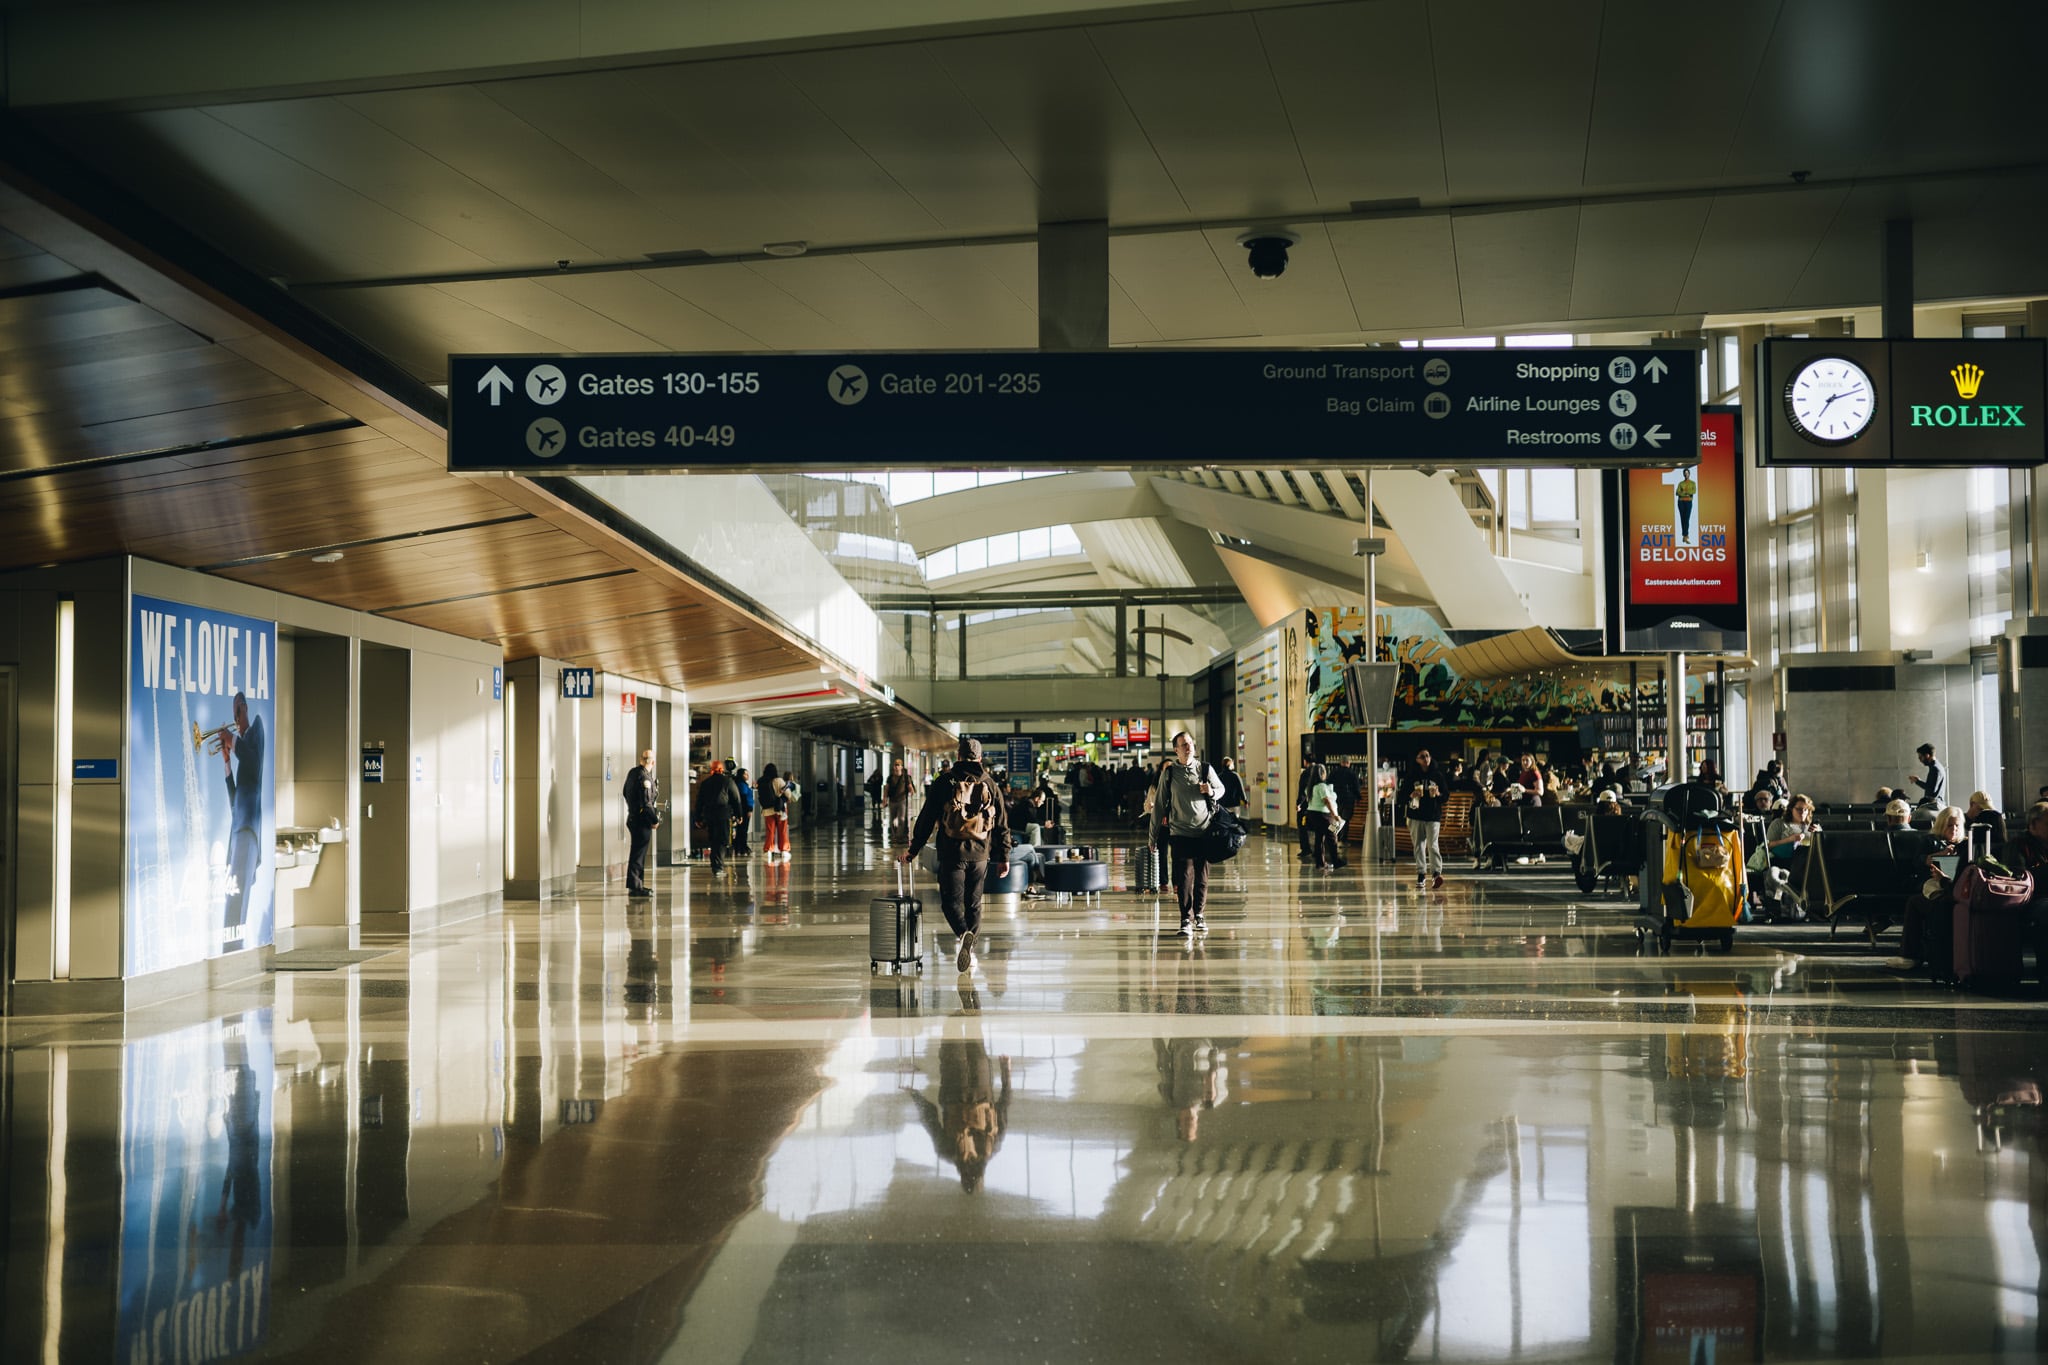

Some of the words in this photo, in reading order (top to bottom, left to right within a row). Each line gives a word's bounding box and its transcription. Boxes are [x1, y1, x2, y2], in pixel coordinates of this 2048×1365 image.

[1263, 364, 1327, 379] Ground
[1332, 364, 1415, 383] Transport
[1516, 363, 1600, 383] Shopping
[578, 373, 655, 396] Gates
[662, 372, 760, 395] 130-155
[880, 373, 937, 395] Gate
[944, 373, 1041, 394] 201-235
[1327, 398, 1360, 416] Bag
[1366, 397, 1415, 413] Claim
[1466, 396, 1521, 412] Airline
[1526, 396, 1600, 416] Lounges
[1911, 405, 2025, 426] ROLEX
[578, 425, 656, 449] Gates
[663, 425, 735, 447] 40-49
[1507, 429, 1601, 446] Restrooms
[1641, 525, 1672, 533] EVERY
[1700, 525, 1726, 533] WITH
[1640, 548, 1726, 561] BELONGS
[1670, 621, 1700, 629] JCDecaux
[140, 609, 177, 690] WE
[185, 618, 239, 697] LOVE
[245, 629, 269, 700] LA
